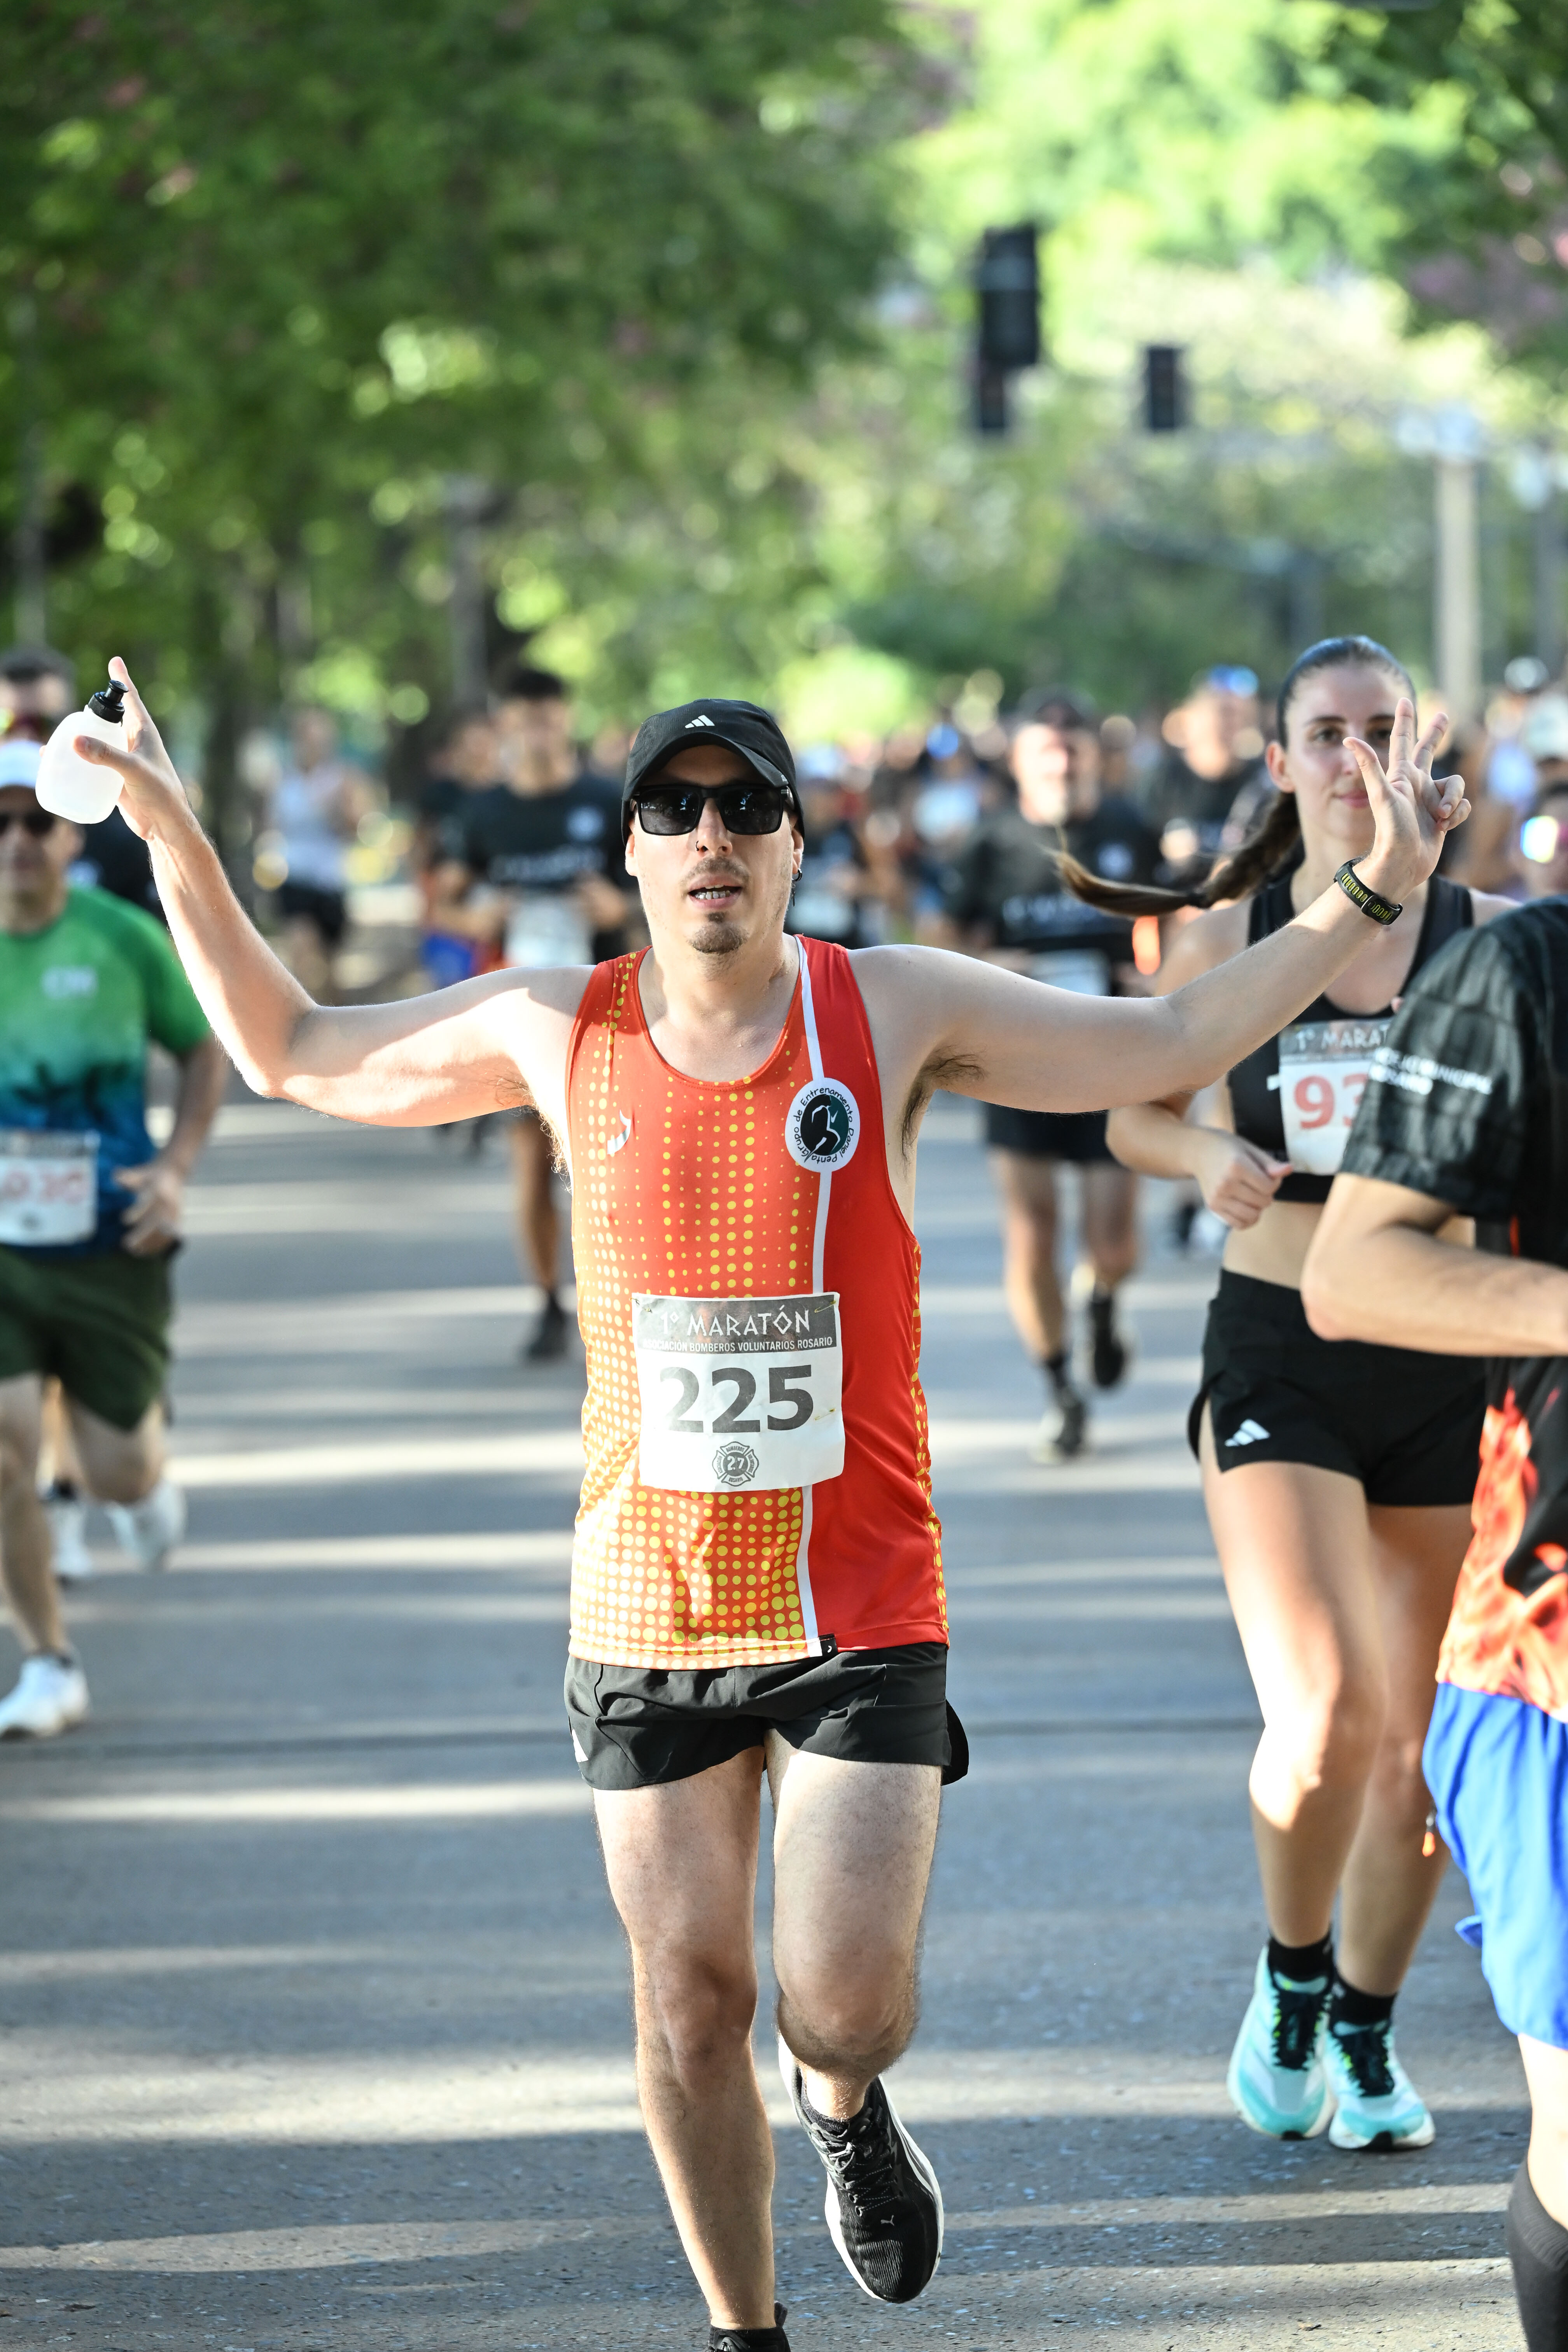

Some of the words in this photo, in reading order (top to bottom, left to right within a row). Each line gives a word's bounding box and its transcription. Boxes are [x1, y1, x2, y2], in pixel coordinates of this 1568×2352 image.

[793, 1109, 803, 1122] de
[800, 1087, 853, 1123] Entrenamiento
[794, 1127, 809, 1157] Grupo
[839, 1127, 854, 1158] Daniel
[687, 1304, 810, 1336] MARATÓN
[642, 1339, 688, 1352] ASOCIACIÓN
[689, 1342, 736, 1353] BOMBEROS
[738, 1340, 795, 1351] VOLUNTARIOS
[797, 1336, 833, 1349] ROSARIO
[660, 1364, 814, 1433] 225
[727, 1456, 745, 1471] 27
